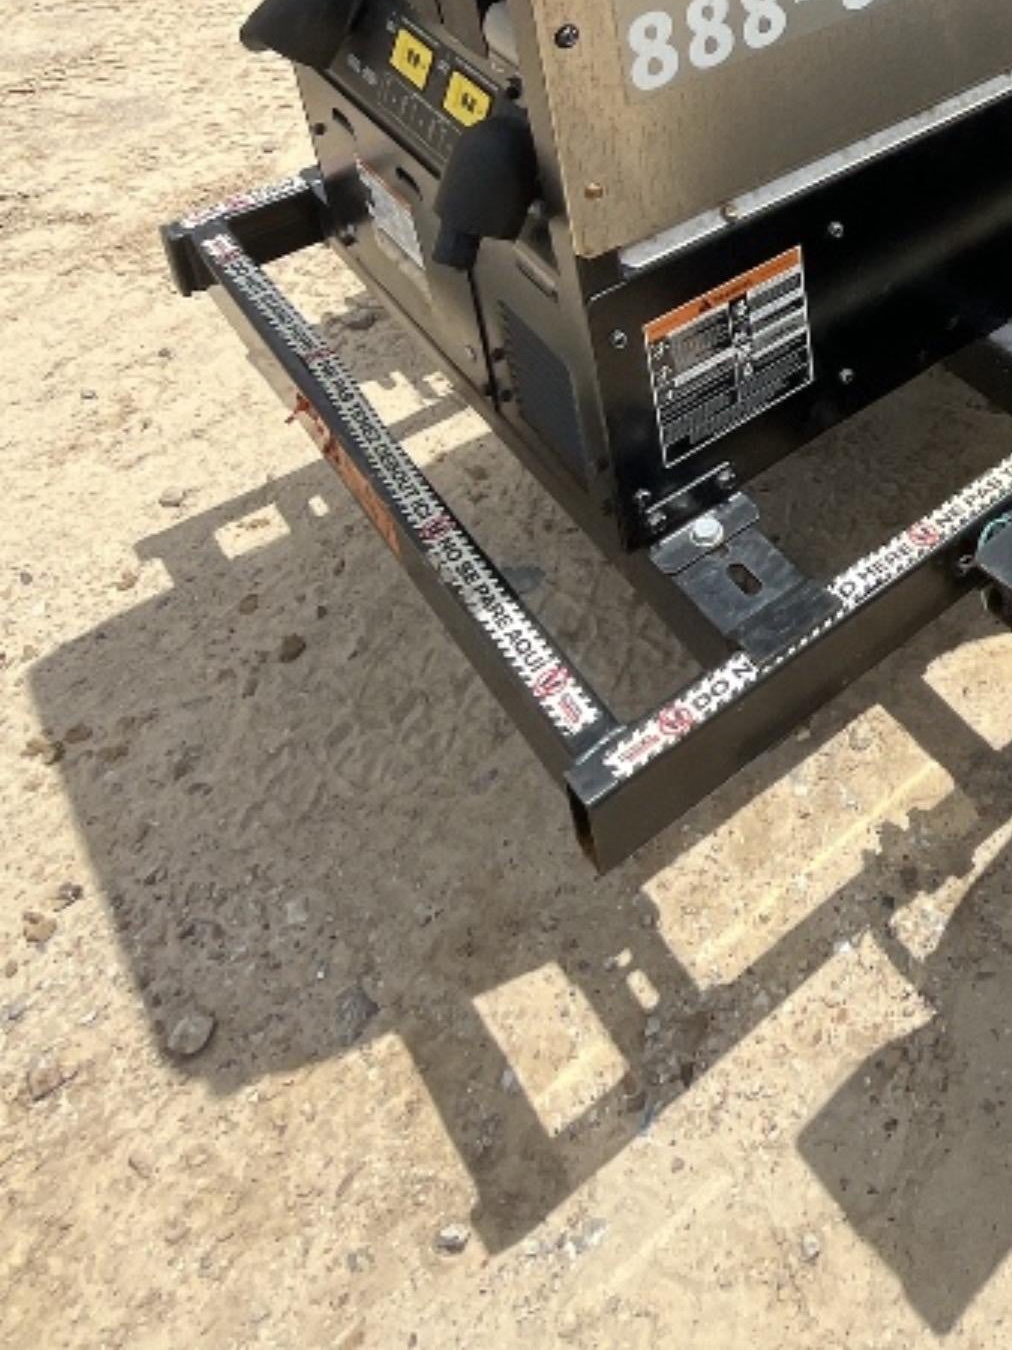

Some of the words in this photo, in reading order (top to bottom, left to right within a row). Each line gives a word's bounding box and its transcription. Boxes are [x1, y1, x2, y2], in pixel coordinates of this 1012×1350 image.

[436, 533, 465, 565] NO
[454, 558, 482, 587] SE
[471, 580, 515, 633] PARE
